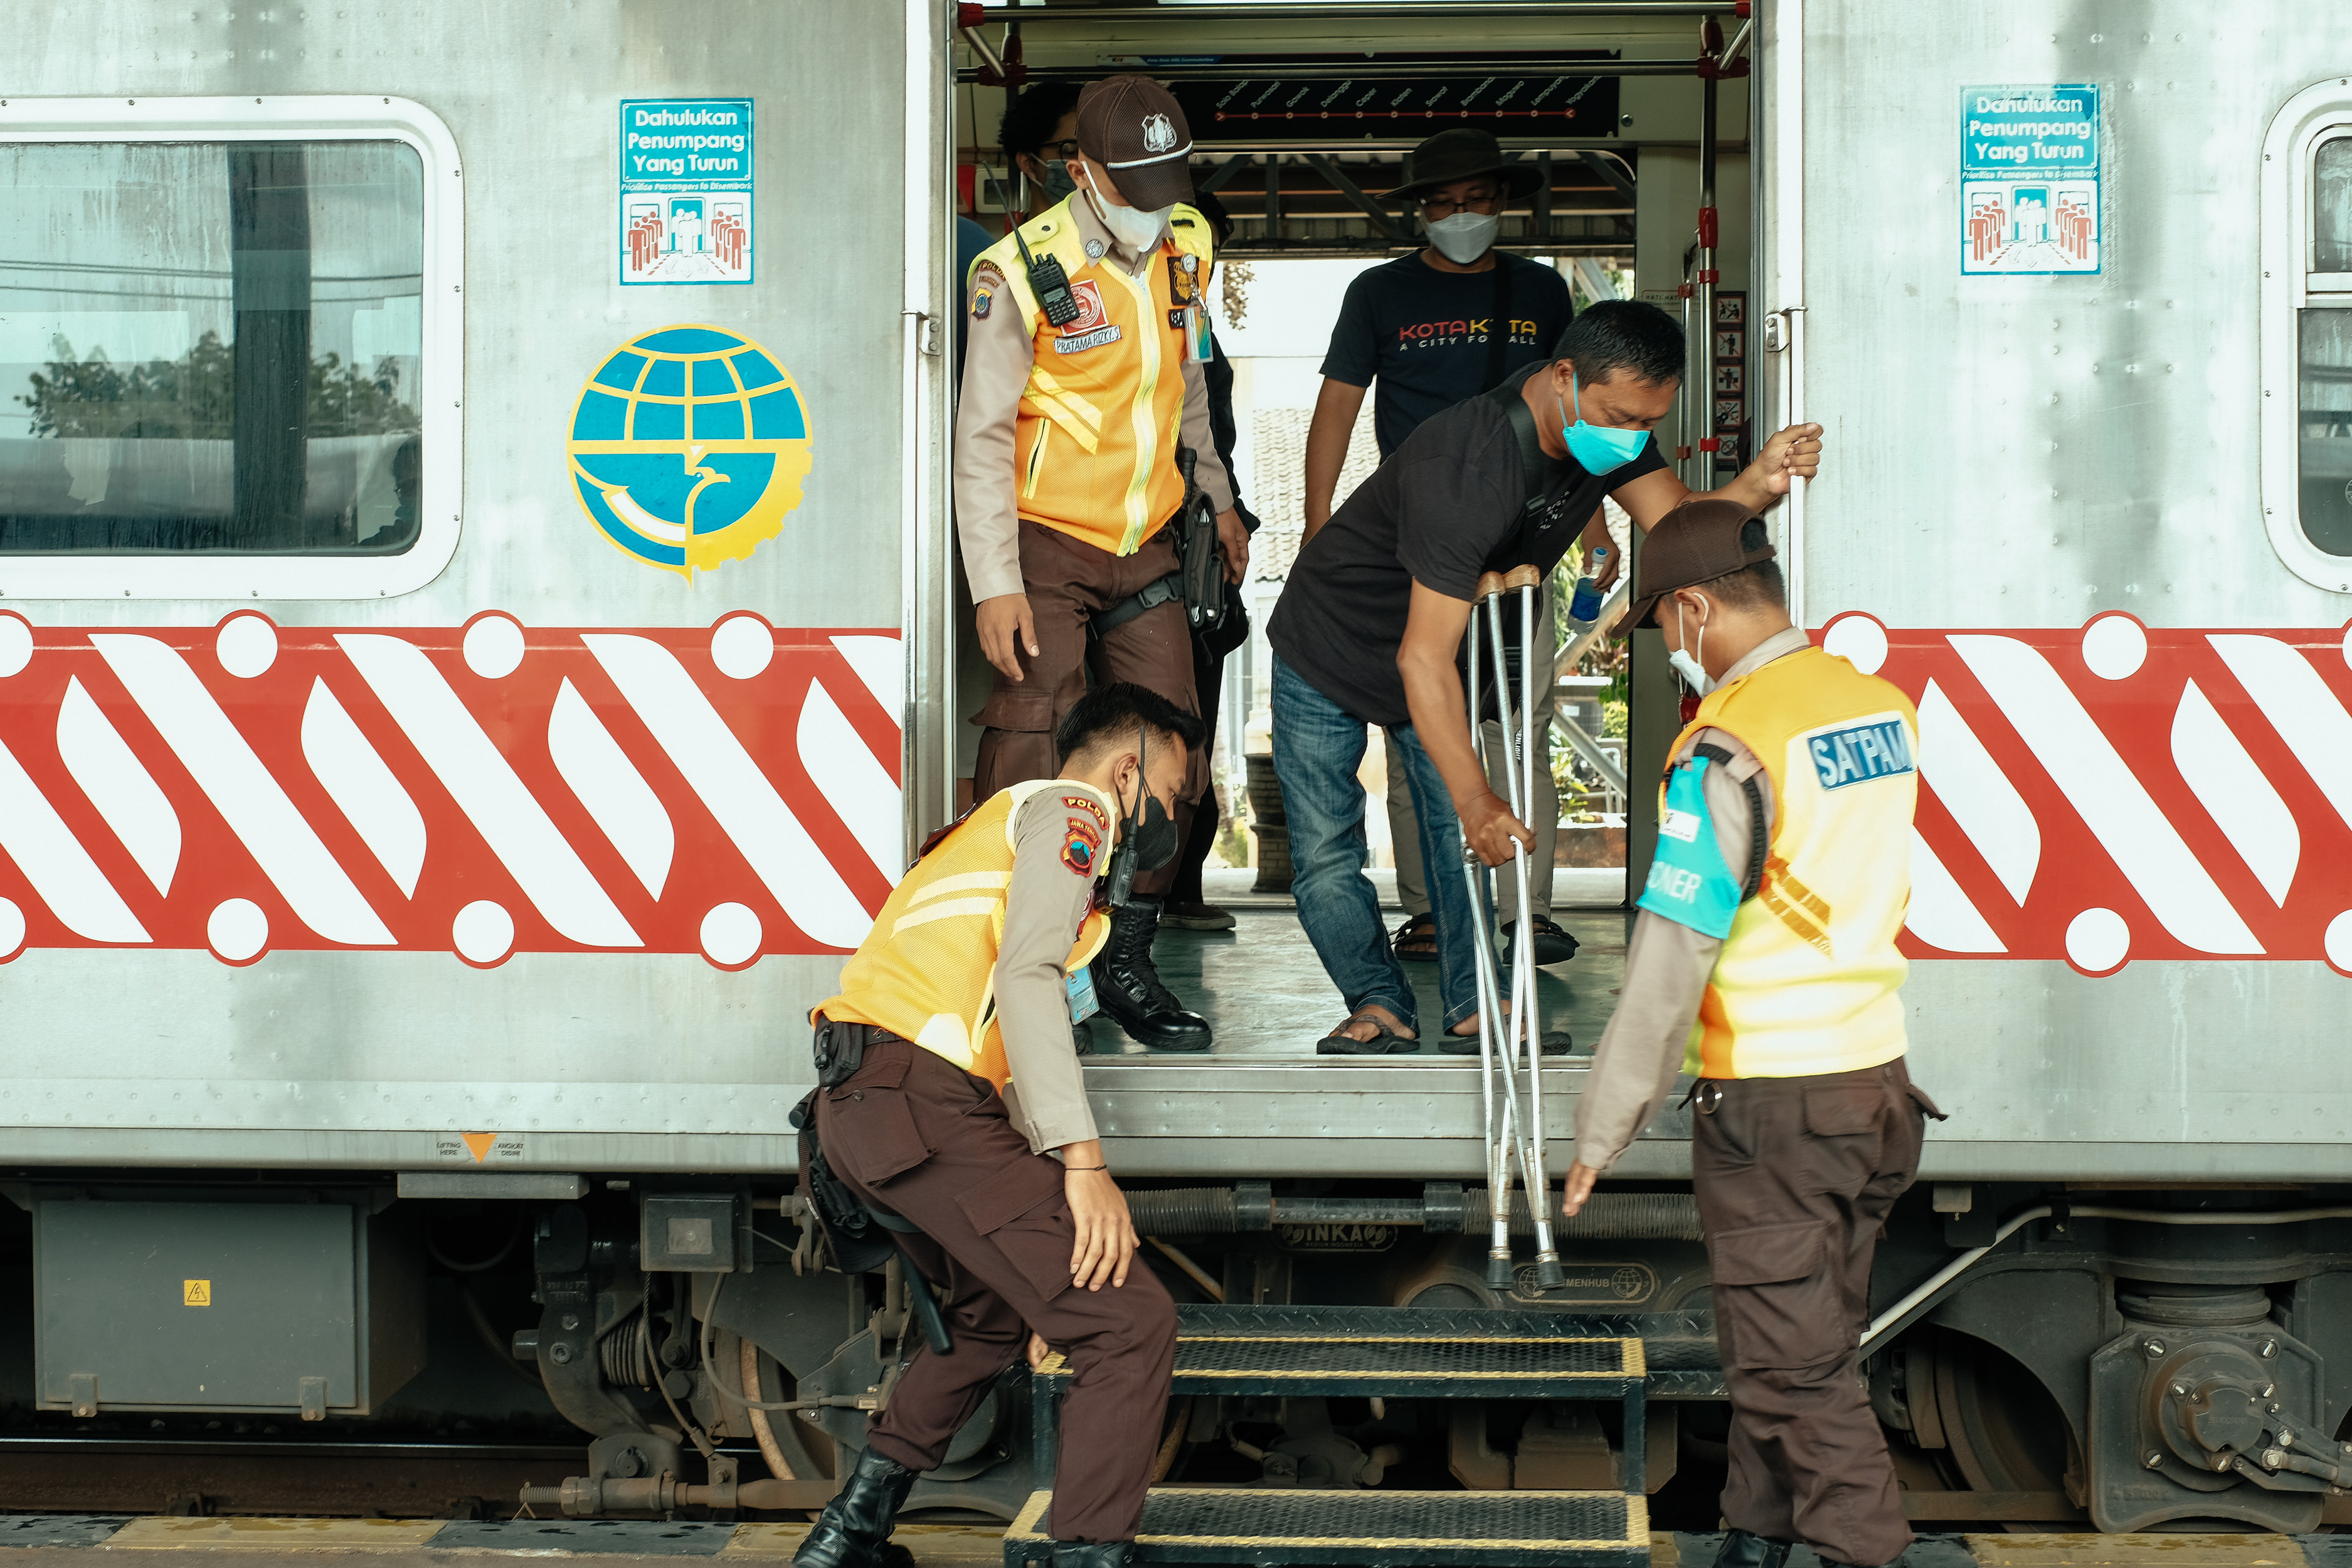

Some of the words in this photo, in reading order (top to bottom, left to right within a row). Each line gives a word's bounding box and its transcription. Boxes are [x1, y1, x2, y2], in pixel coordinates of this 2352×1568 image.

[1215, 95, 1232, 109] Solo
[1286, 86, 1310, 107] Gawok
[1320, 80, 1352, 108] Delanggu
[1977, 97, 2083, 113] Dahulukan
[635, 109, 738, 126] Dahulukan
[1969, 120, 2090, 139] Penumpang
[628, 132, 745, 152] Penumpang
[1975, 142, 2028, 163] Yang
[2032, 142, 2084, 159] Turun
[633, 155, 685, 175] Yang
[687, 154, 738, 171] Turun
[700, 182, 709, 190] to
[982, 262, 1005, 279] POLDA
[1057, 336, 1092, 352] PRATAMA
[1399, 343, 1409, 352] A
[1418, 336, 1458, 348] CITY
[1468, 335, 1488, 344] FO
[1508, 335, 1536, 345] ALL
[1811, 723, 1912, 787] SATPAM
[1067, 798, 1105, 826] POLDA
[1070, 820, 1084, 829] JAWA
[1306, 1224, 1363, 1241] INKA
[1564, 1278, 1610, 1288] MENHUB
